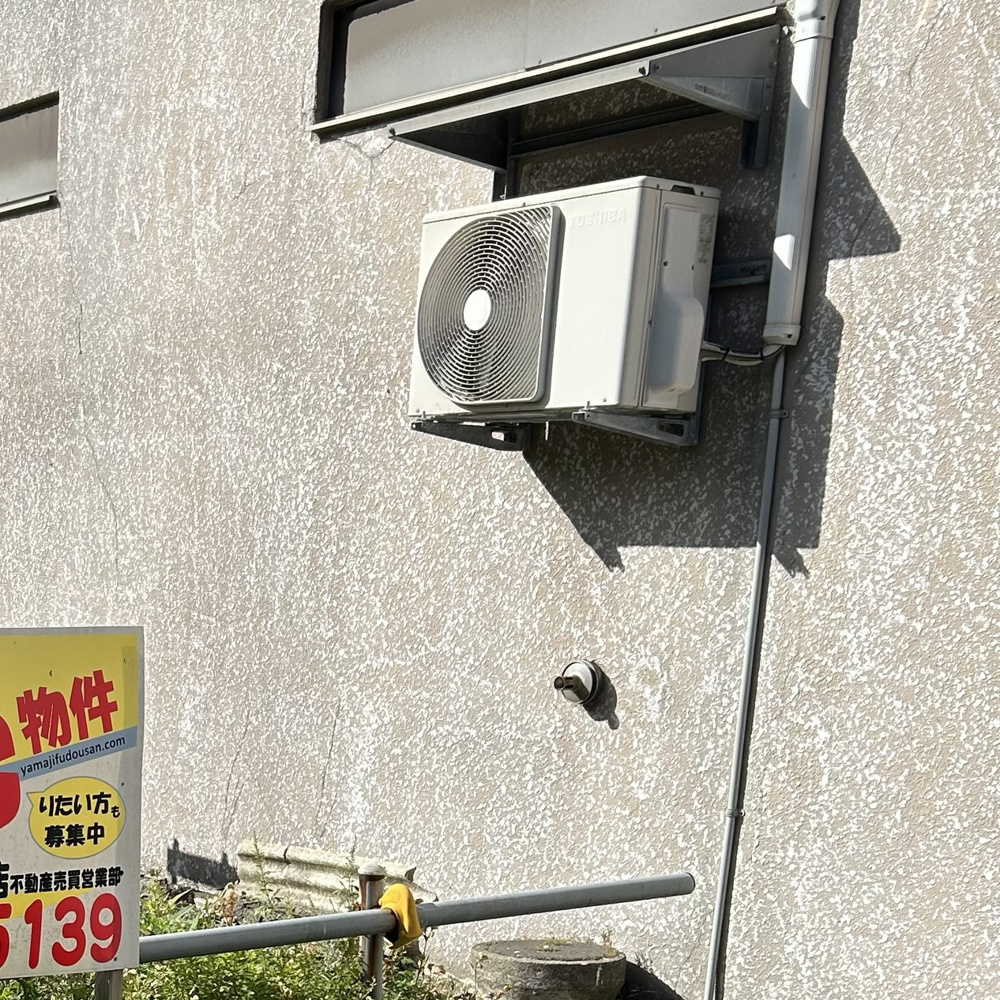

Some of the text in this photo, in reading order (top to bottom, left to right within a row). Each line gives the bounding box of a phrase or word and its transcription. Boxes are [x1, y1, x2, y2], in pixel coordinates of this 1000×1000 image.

[570, 208, 627, 229] TOSHIBA
[16, 669, 118, 755] 物件
[20, 736, 126, 777] yamajifudousan.com
[44, 822, 105, 848] 募集中
